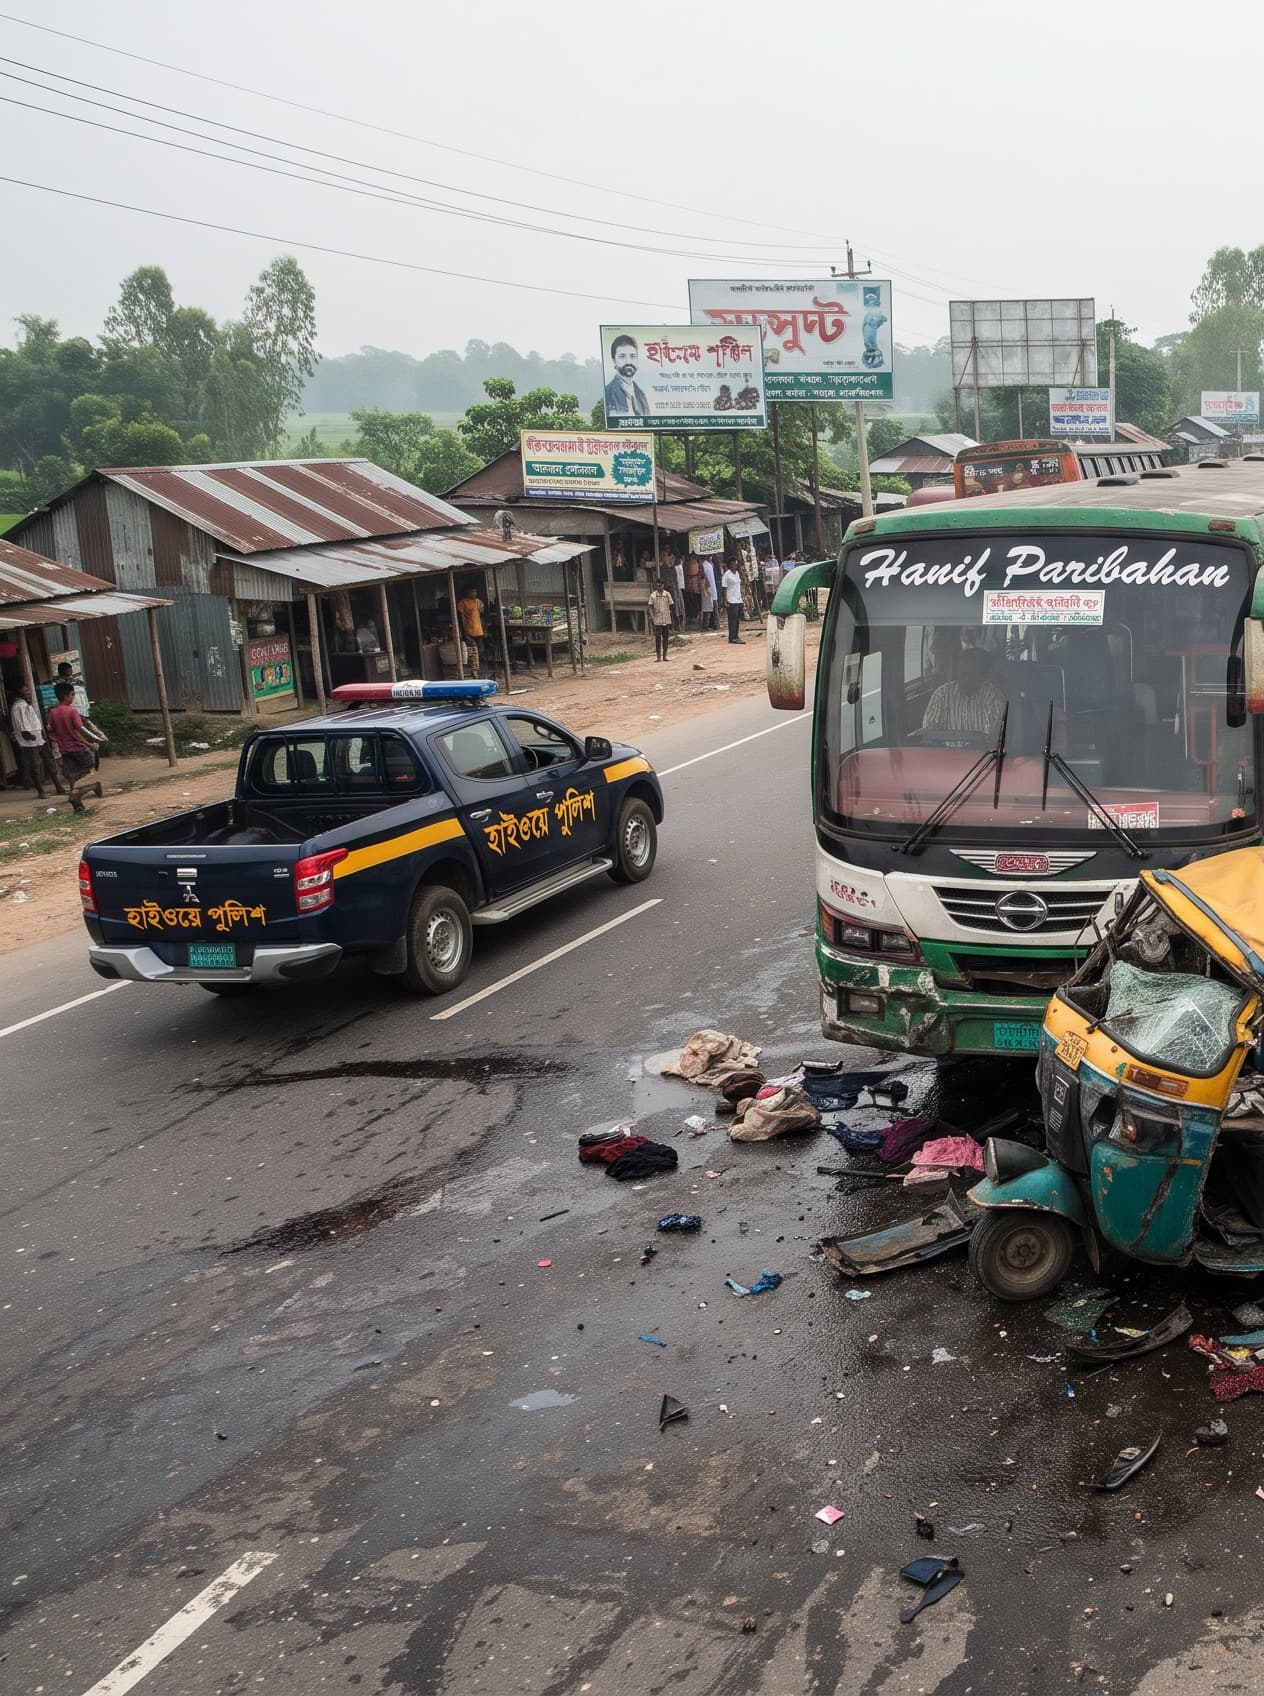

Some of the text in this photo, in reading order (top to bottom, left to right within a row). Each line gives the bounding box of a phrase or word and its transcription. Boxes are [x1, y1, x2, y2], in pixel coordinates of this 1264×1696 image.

[859, 545, 1231, 598] Hanif Paribahan
[483, 787, 596, 856] হাইওয়ে পুলিশ
[123, 898, 268, 932] হাইওয়ে পুলিশ
